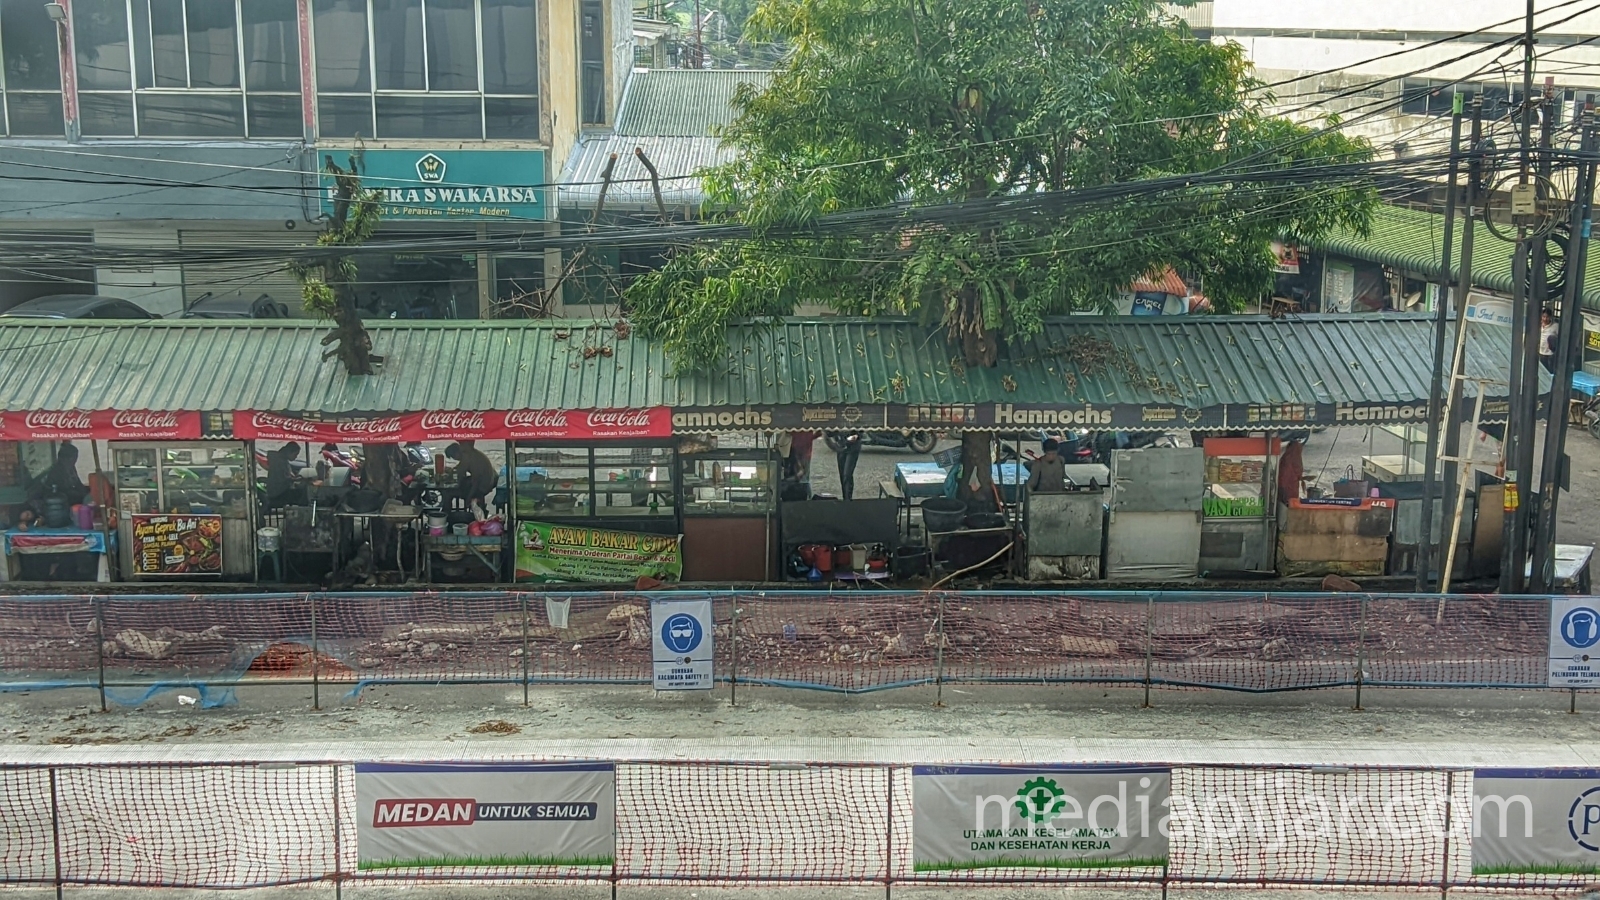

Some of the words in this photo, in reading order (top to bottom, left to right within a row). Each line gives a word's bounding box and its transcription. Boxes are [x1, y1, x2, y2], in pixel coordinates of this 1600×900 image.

[424, 187, 538, 203] SWAKARSA
[480, 207, 510, 217] Modern
[1135, 298, 1162, 310] CAMEL
[672, 406, 772, 426] annochs
[995, 403, 1112, 424] Hannochs
[1335, 402, 1447, 421] Hannoc
[135, 523, 154, 539] Ayam
[154, 520, 177, 534] Geprek
[177, 518, 187, 532] Bu
[187, 518, 198, 530] Ani
[548, 527, 588, 547] AYAM
[590, 530, 639, 551] BAKAR
[549, 546, 583, 556] Menerima
[584, 549, 611, 558] Orderan
[612, 551, 632, 560] Partai
[376, 802, 473, 823] MEDAN
[478, 805, 532, 818] UNTUK
[535, 805, 591, 818] SEMUA
[963, 829, 1028, 839] UTAMAKAN
[1031, 828, 1119, 838] KESELAMATAN
[970, 841, 995, 851] DAN
[998, 841, 1068, 851] KESEHATAN
[1071, 840, 1111, 851] KERJA
